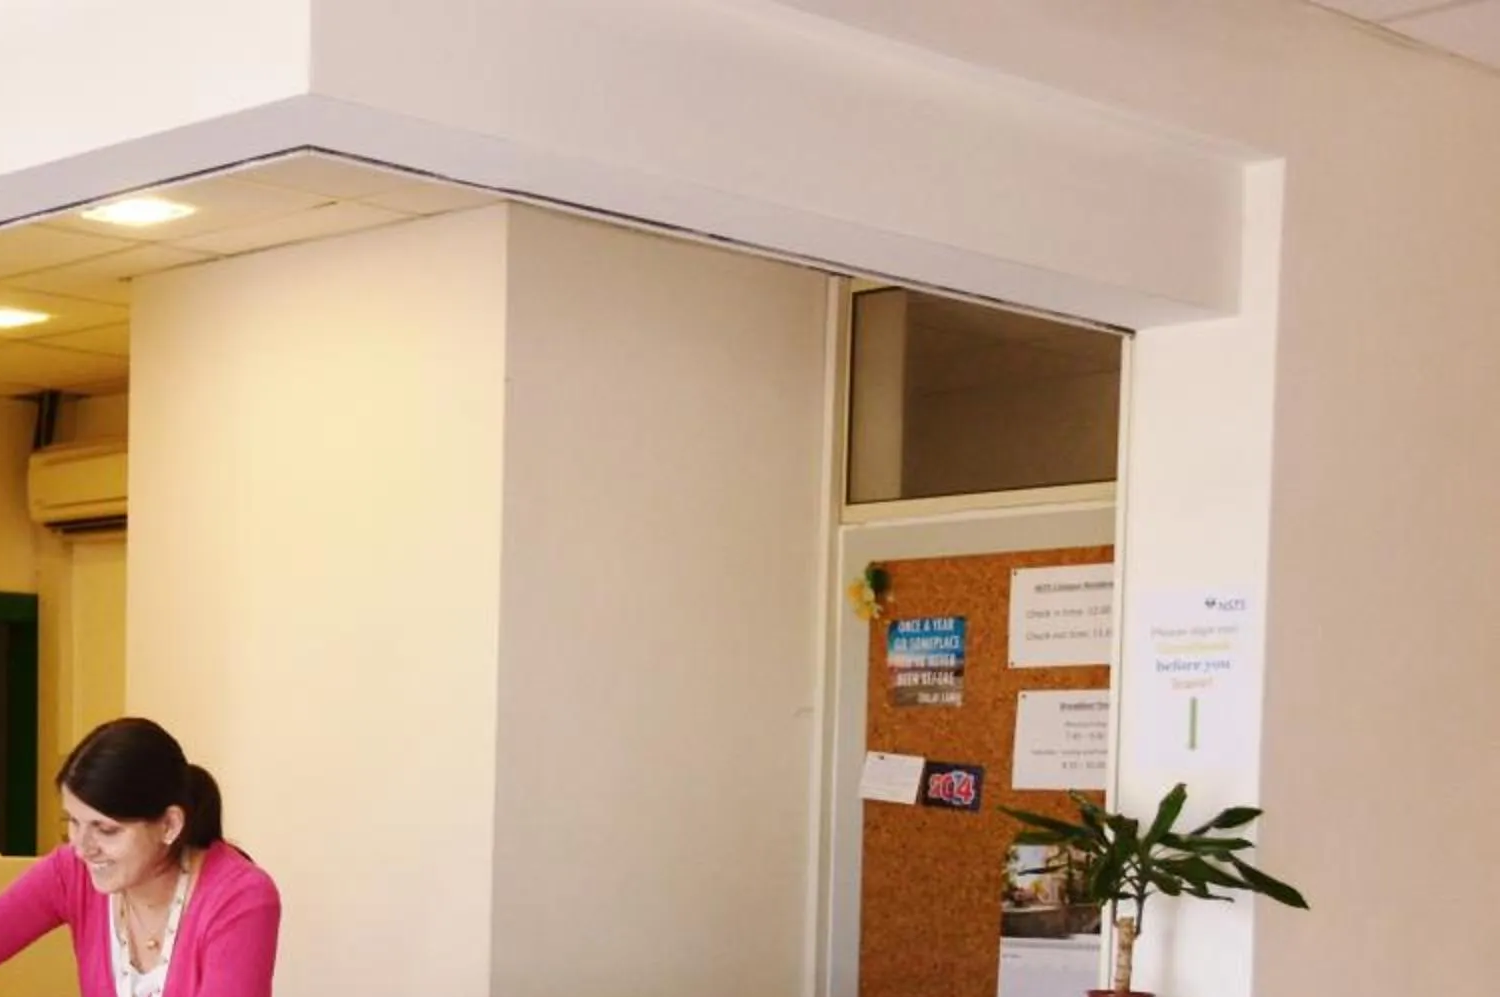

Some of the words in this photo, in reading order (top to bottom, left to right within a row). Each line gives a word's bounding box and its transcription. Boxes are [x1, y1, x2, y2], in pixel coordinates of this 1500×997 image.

[933, 616, 955, 631] YEAR
[1156, 658, 1202, 673] before
[1204, 659, 1231, 673] you
